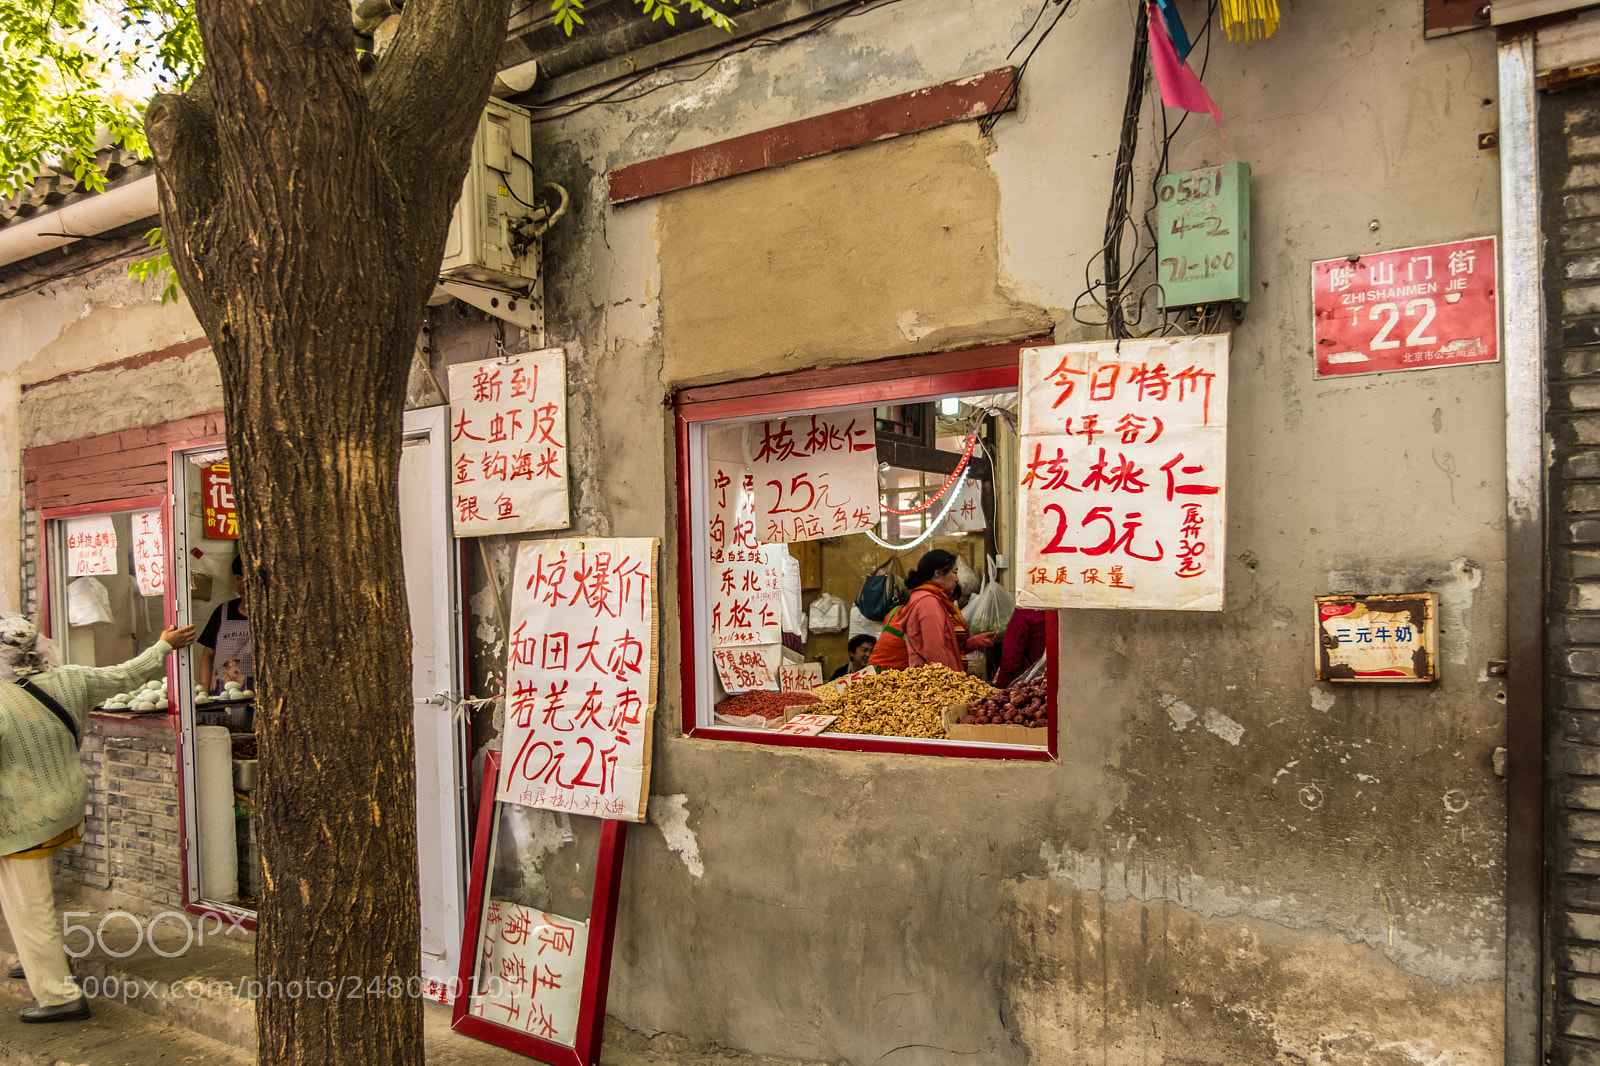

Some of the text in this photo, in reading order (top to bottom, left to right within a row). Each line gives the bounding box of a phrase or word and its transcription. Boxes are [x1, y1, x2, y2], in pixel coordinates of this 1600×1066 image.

[1330, 250, 1476, 293] 陟山门街
[1445, 278, 1467, 291] JIE
[1369, 297, 1438, 351] 22
[472, 364, 538, 403] 新到
[1044, 355, 1216, 426] 今日特价
[452, 402, 565, 449] 大虾皮
[753, 414, 876, 463] 核桃仁
[454, 447, 563, 485] 金钩海米
[1020, 443, 1220, 502] 核桃仁
[456, 492, 520, 523] 银鱼
[766, 472, 851, 514] 25元
[767, 505, 876, 543] 补脑乌发
[1040, 503, 1164, 562] 25元
[526, 551, 650, 621] 惊爆价
[720, 567, 761, 596] 东北
[508, 620, 643, 682] 和田大枣
[1337, 626, 1412, 643] 三元牛奶
[735, 669, 763, 688] 38元
[506, 729, 618, 795] 10元2斤
